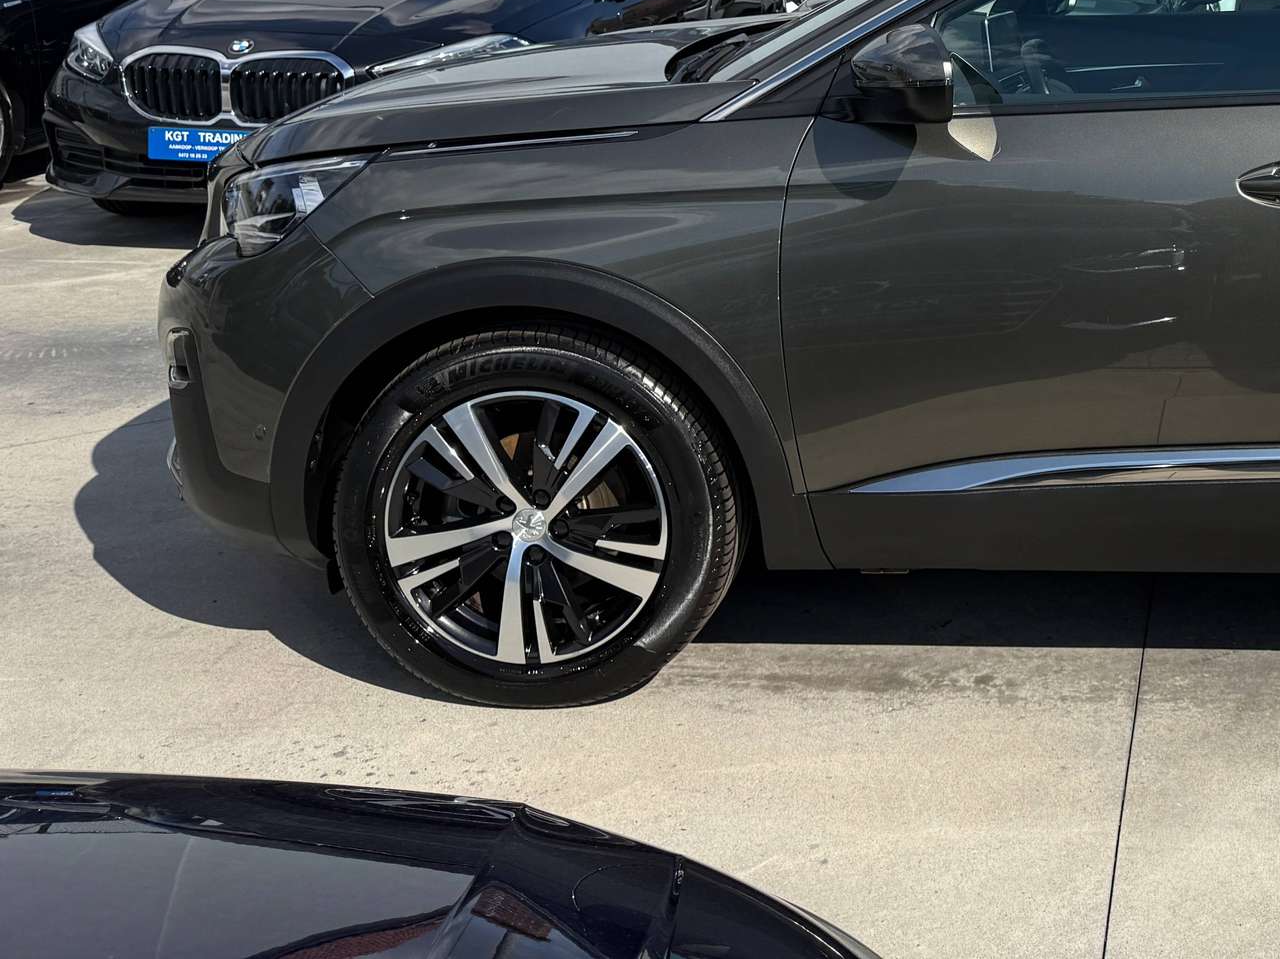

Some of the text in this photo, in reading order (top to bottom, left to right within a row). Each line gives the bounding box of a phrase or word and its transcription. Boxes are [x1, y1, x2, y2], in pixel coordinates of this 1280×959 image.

[165, 130, 246, 144] KGT TRADIN
[448, 356, 566, 384] MICHELIN
